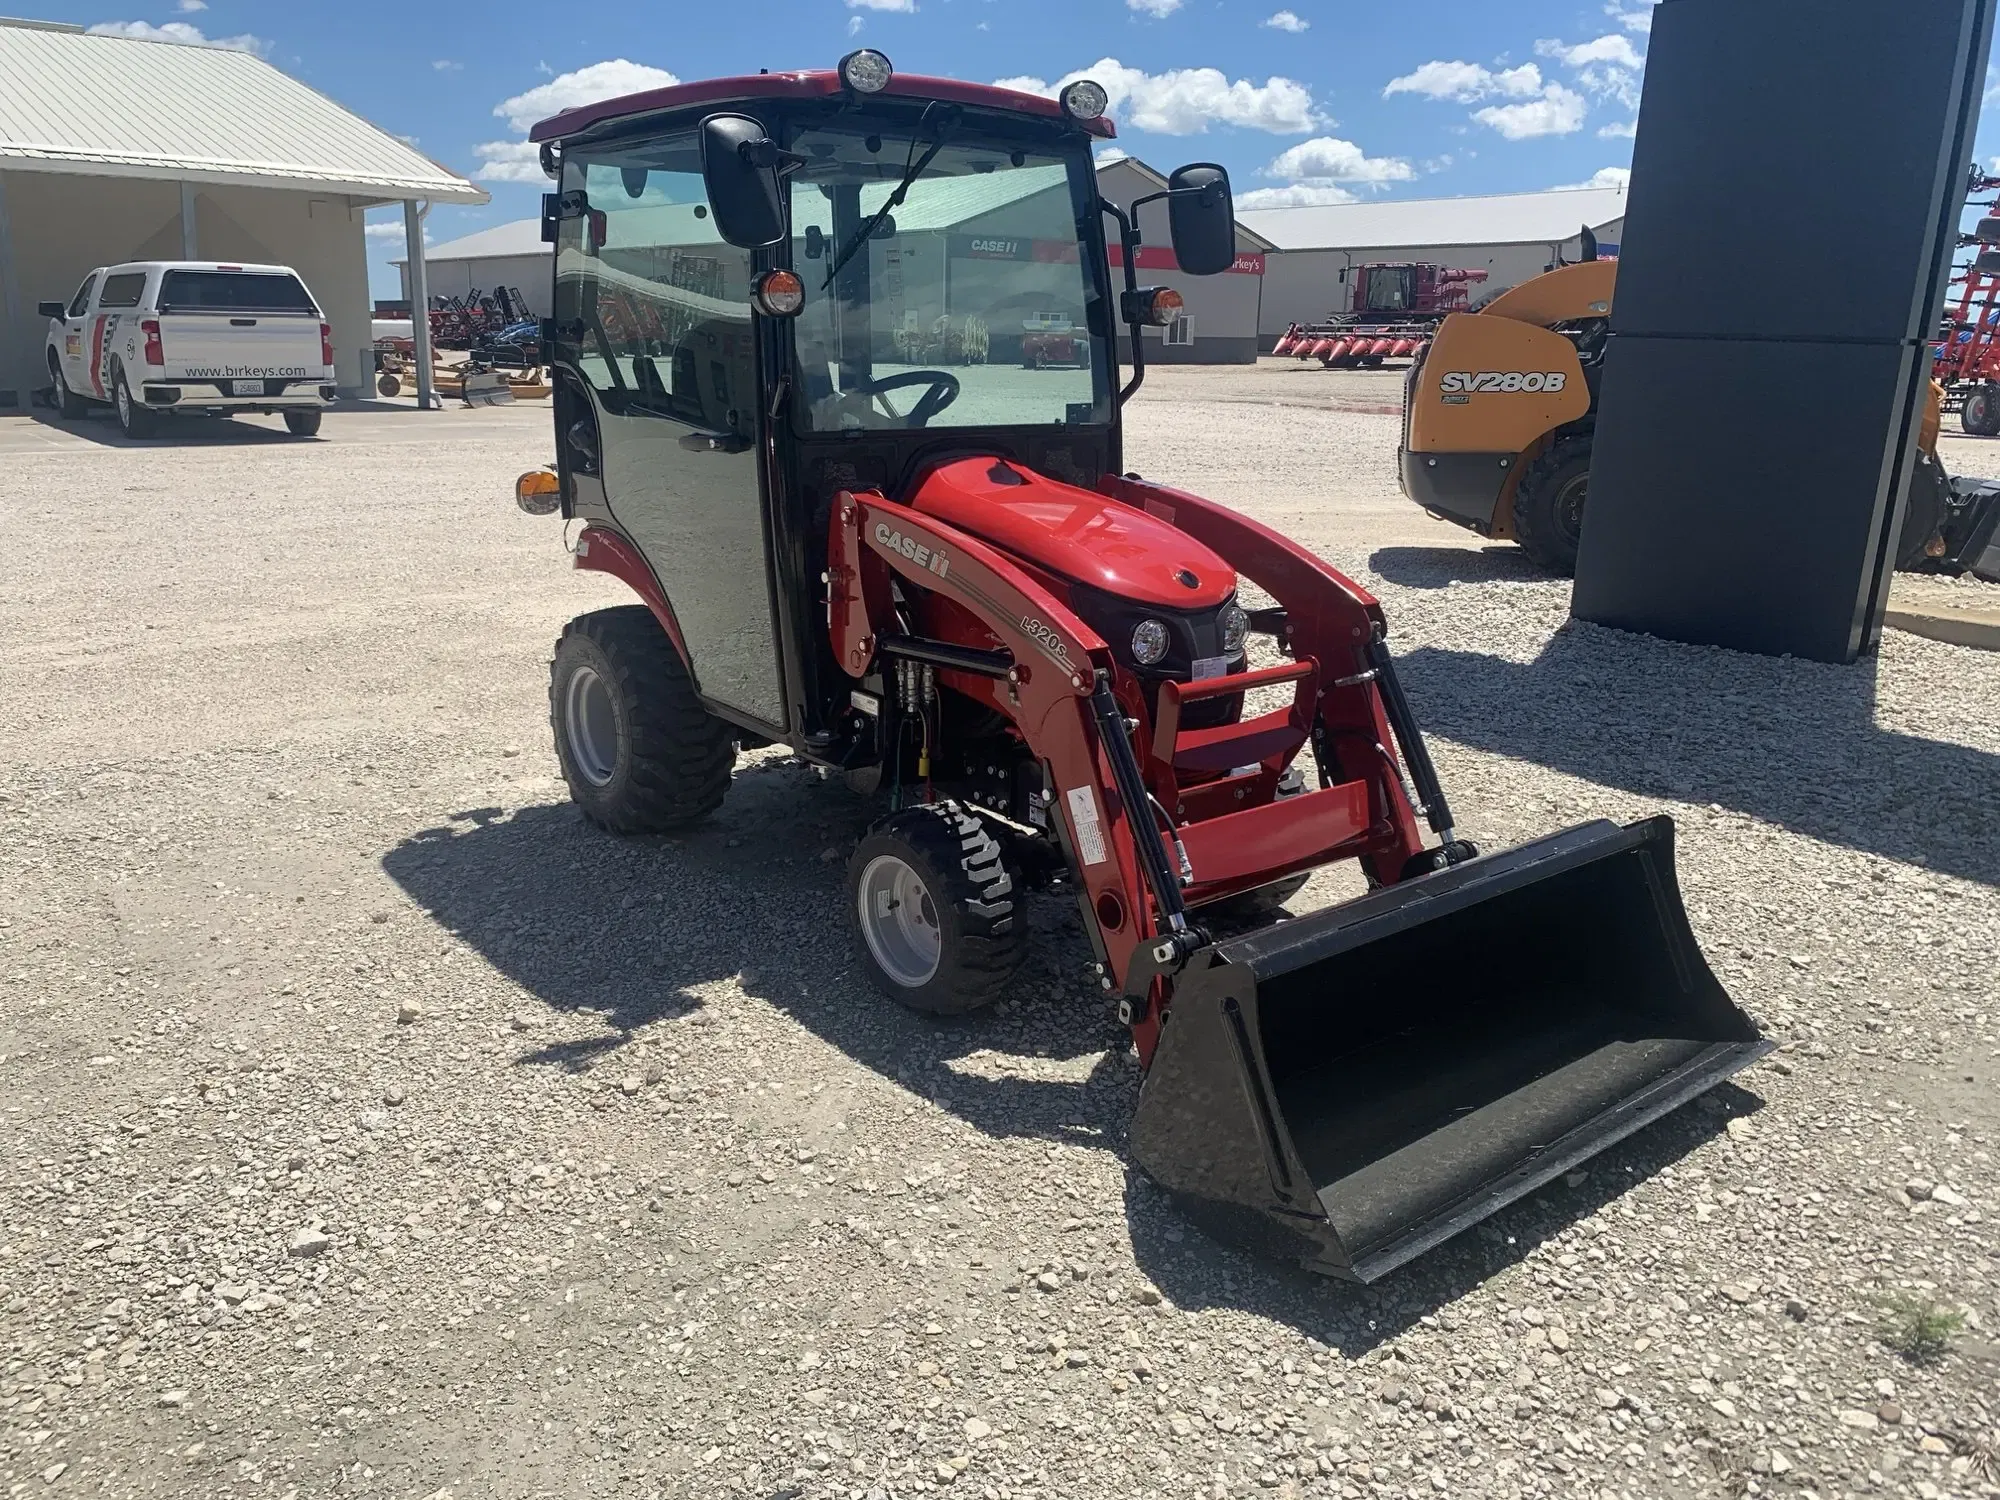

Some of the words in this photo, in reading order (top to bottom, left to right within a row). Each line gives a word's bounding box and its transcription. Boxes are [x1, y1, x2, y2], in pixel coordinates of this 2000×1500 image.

[971, 239, 1005, 252] CASE
[185, 365, 306, 379] www.birkeys.com
[1439, 371, 1567, 394] SV280B
[875, 522, 930, 568] CASE
